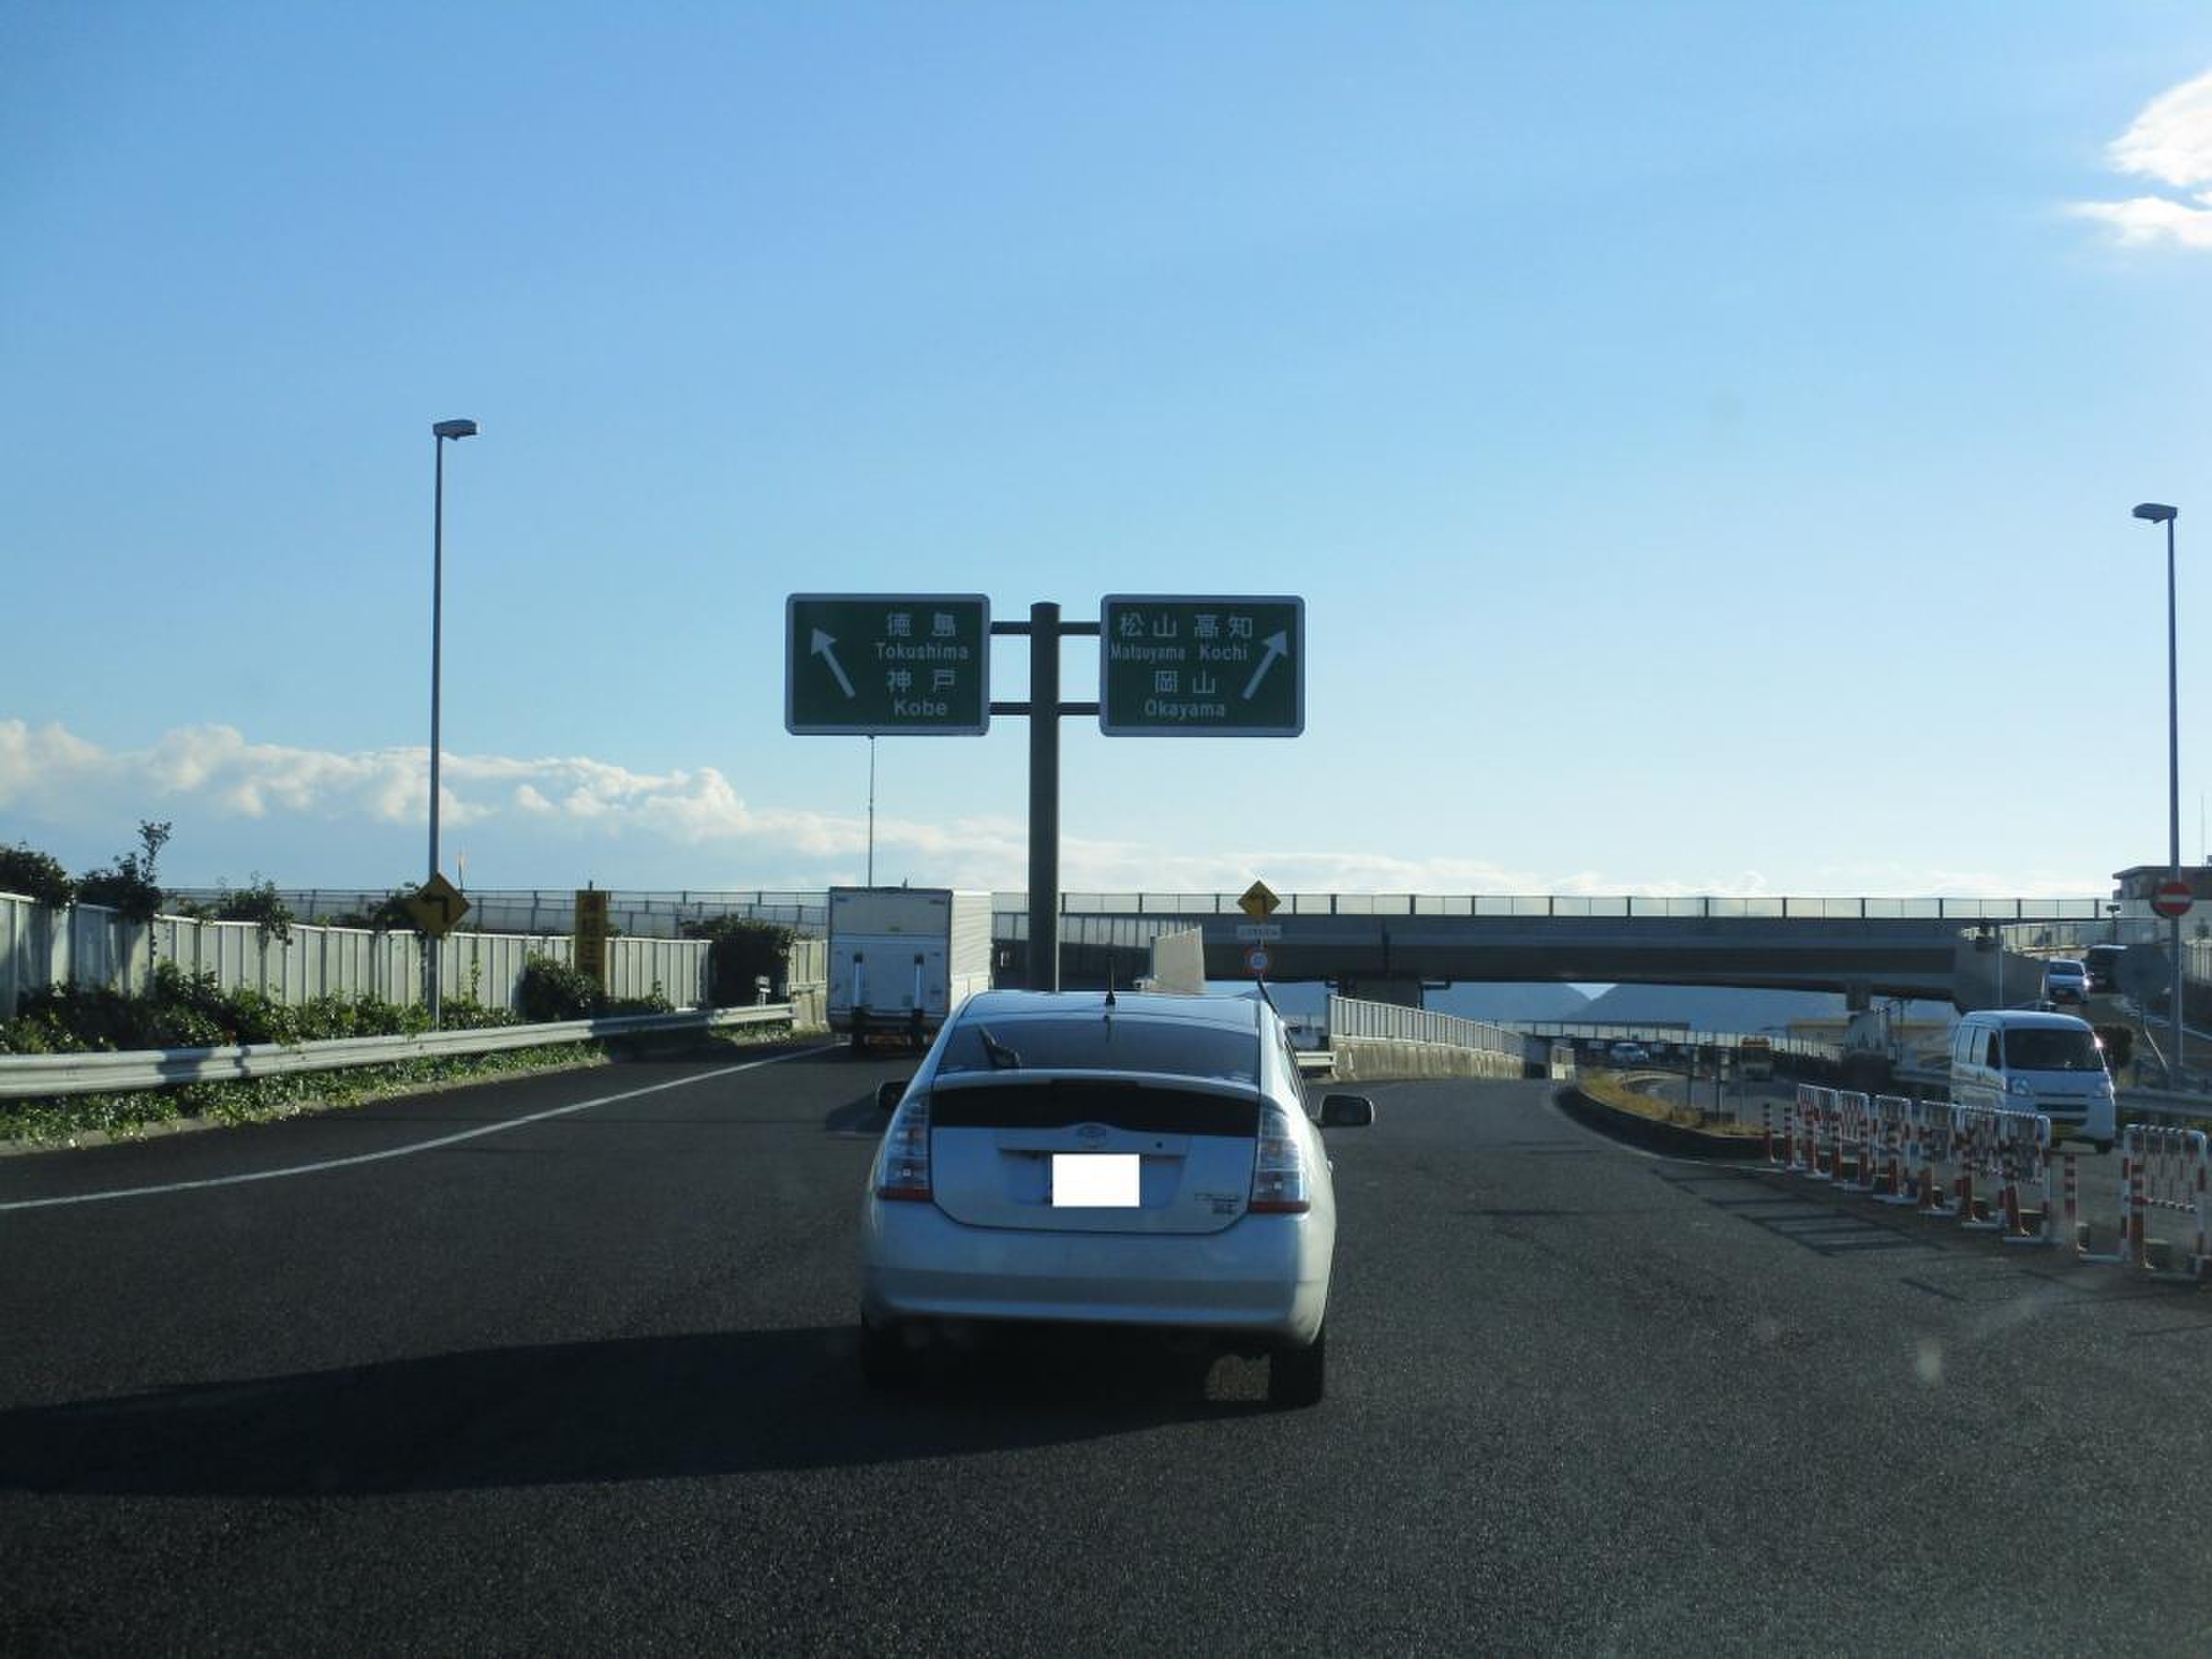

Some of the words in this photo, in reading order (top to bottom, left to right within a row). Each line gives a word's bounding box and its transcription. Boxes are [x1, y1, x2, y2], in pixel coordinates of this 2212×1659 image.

[888, 612, 956, 637] 徳島
[1120, 613, 1178, 637] 松山
[1194, 614, 1253, 639] 高知
[875, 642, 970, 660] Tokushima
[1111, 644, 1185, 664] Matsuyama
[1199, 645, 1248, 661] Kochi
[887, 668, 956, 693] 神戸
[1155, 670, 1216, 694] 岡山
[893, 698, 948, 716] Kobe
[1144, 700, 1225, 720] Okayama
